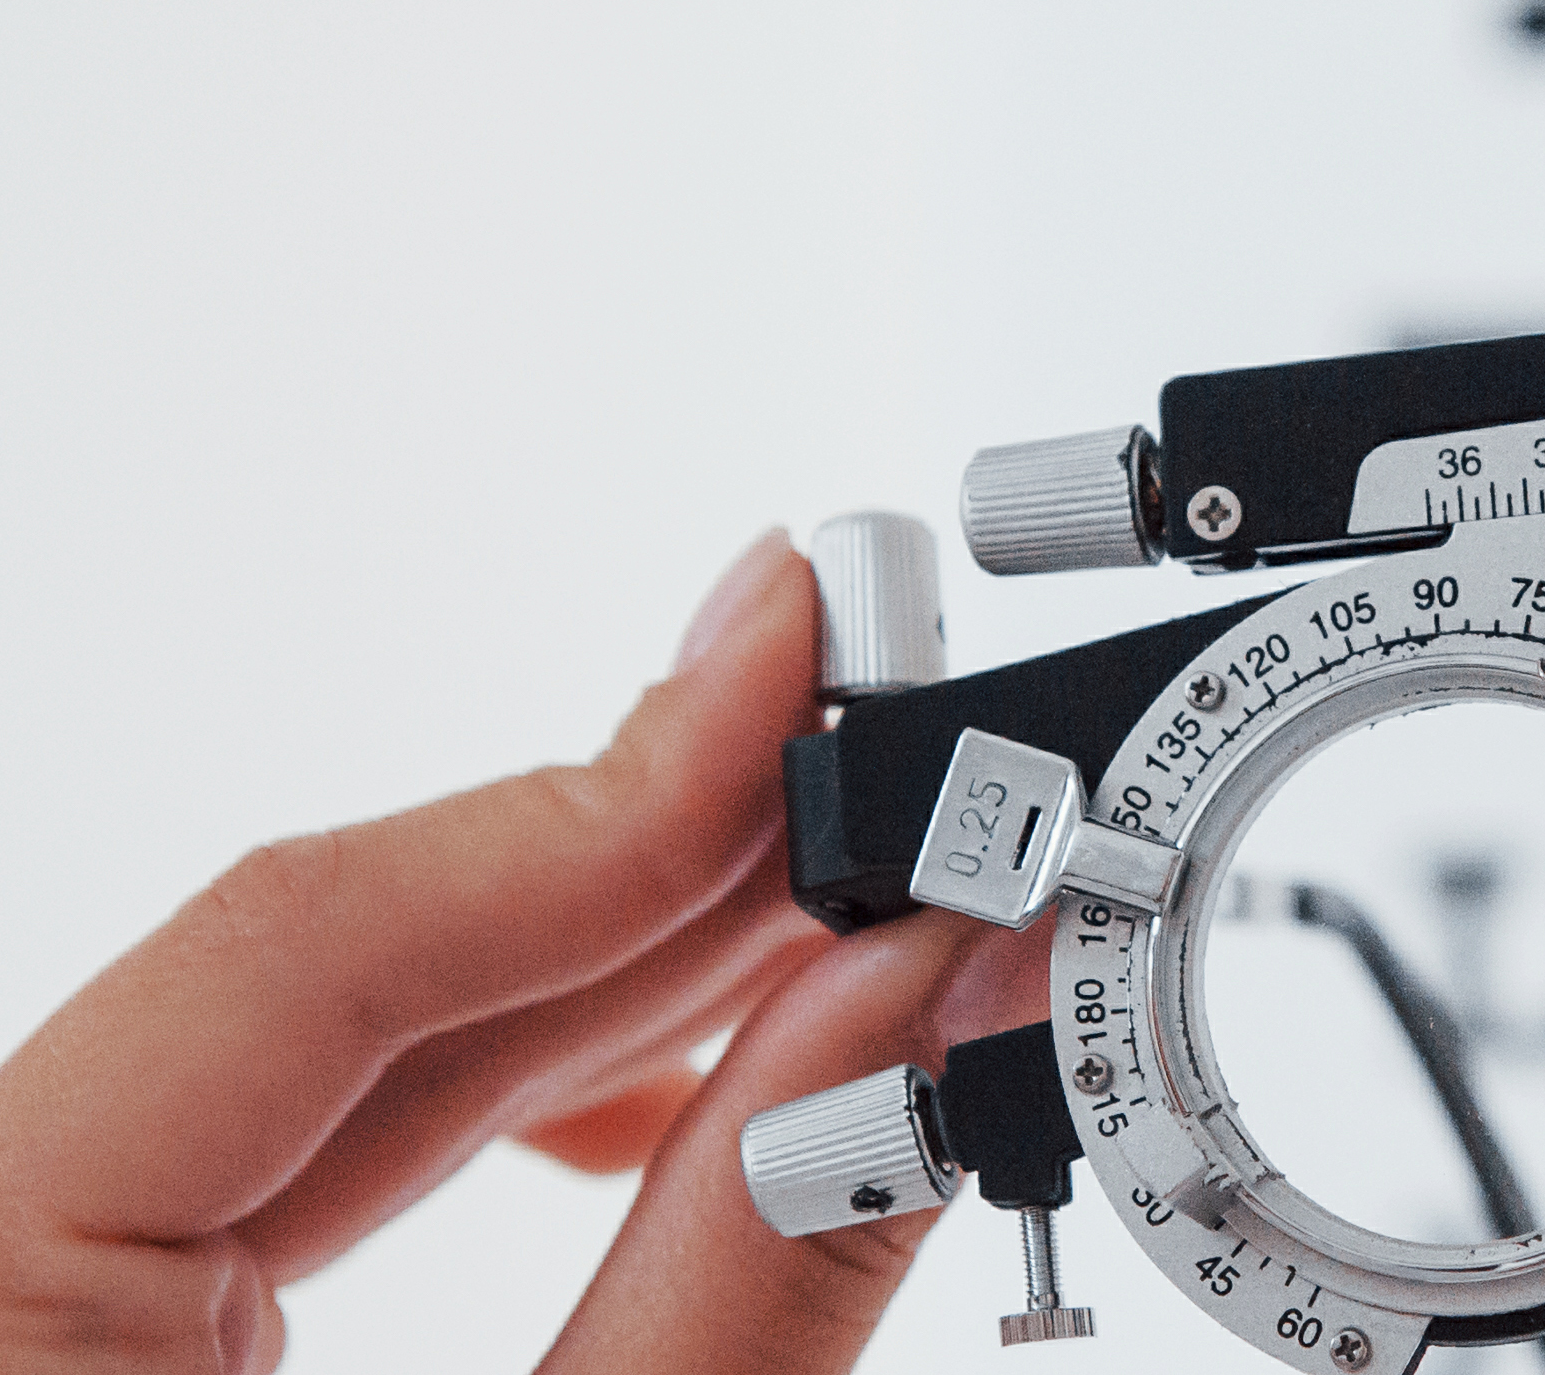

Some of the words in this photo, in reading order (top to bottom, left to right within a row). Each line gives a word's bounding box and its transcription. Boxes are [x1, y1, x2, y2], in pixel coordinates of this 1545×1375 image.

[1438, 446, 1482, 479] 36
[1309, 592, 1376, 639] 105
[1413, 576, 1459, 610] 90
[1228, 633, 1290, 687] 120
[1146, 711, 1202, 773] 135
[945, 777, 1007, 878] 0.25
[1111, 785, 1152, 831] 50
[1078, 903, 1112, 946] 16
[1074, 978, 1107, 1046] 180
[1092, 1092, 1130, 1137] 15
[1195, 1255, 1241, 1296] 45
[1277, 1308, 1324, 1349] 60
